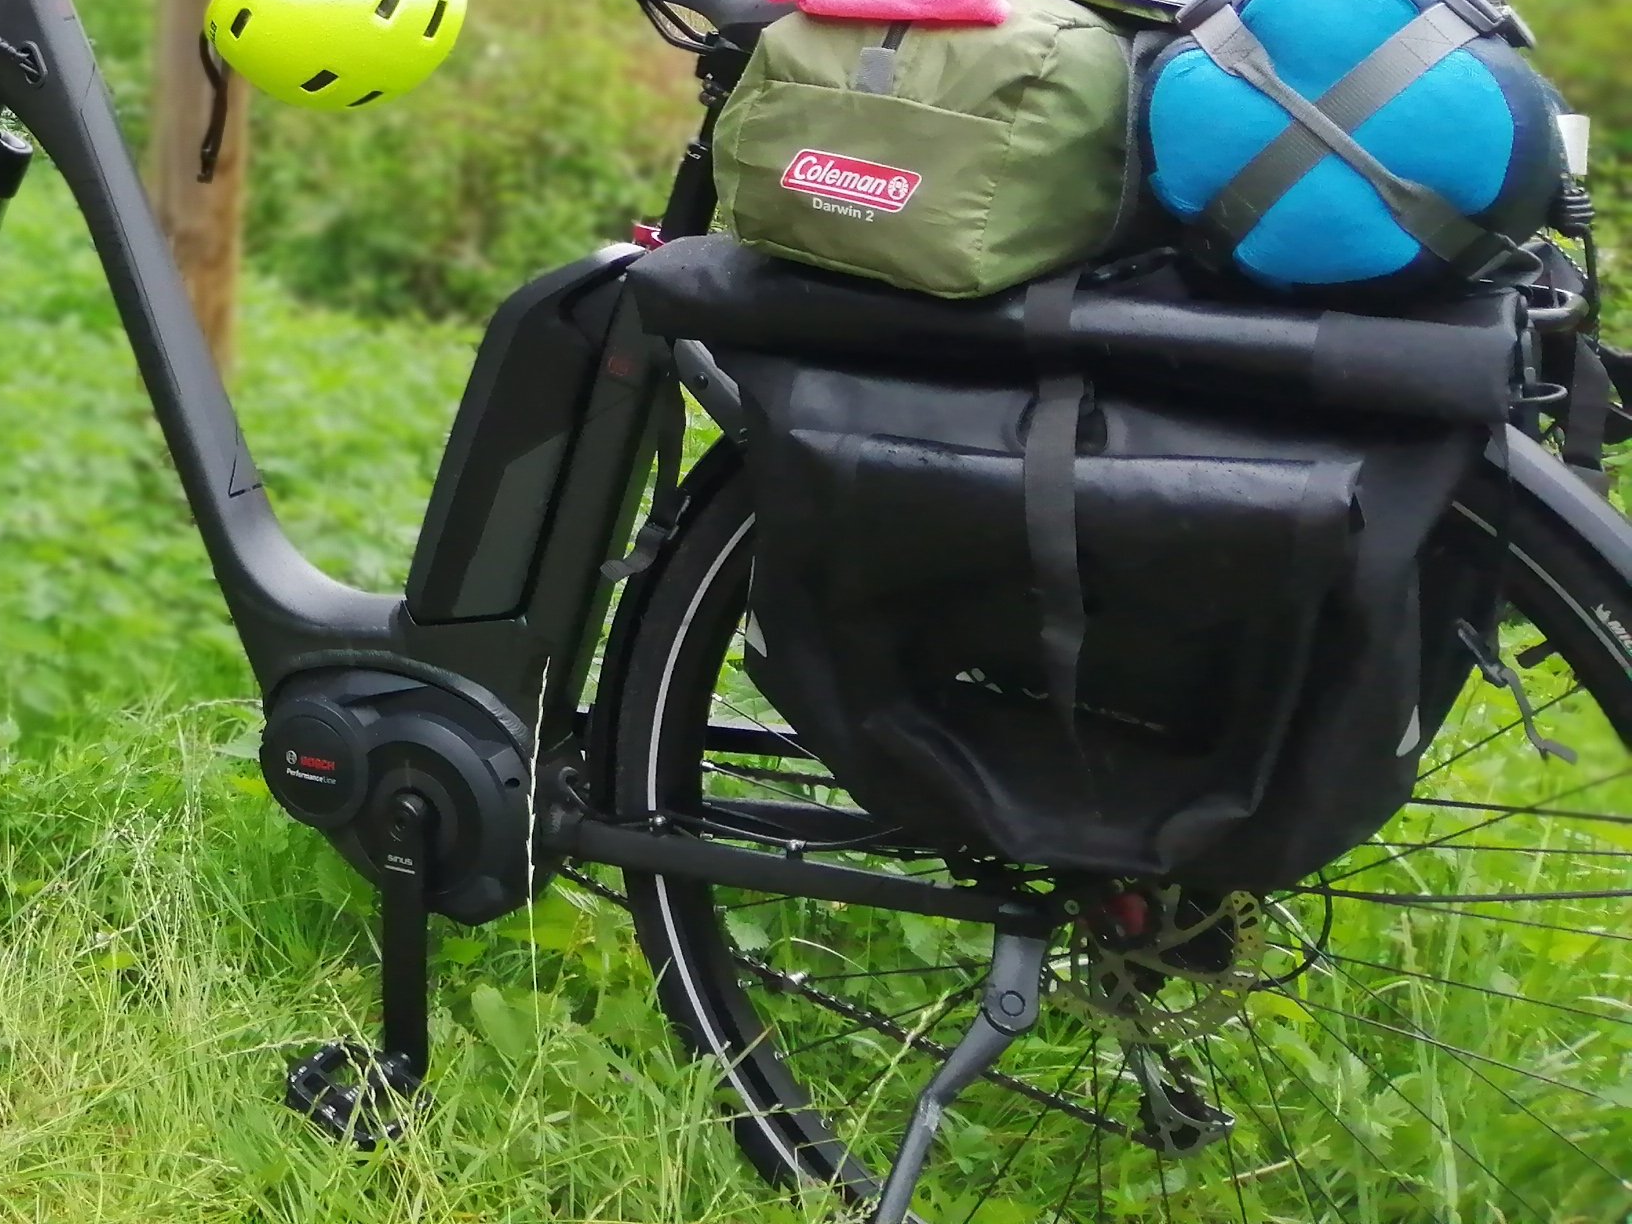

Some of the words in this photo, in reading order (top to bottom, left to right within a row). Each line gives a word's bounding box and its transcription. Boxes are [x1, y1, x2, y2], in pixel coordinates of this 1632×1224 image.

[793, 155, 888, 196] Coleman
[812, 197, 862, 220] Darwin
[865, 210, 875, 223] 2
[300, 755, 335, 771] BOSCH
